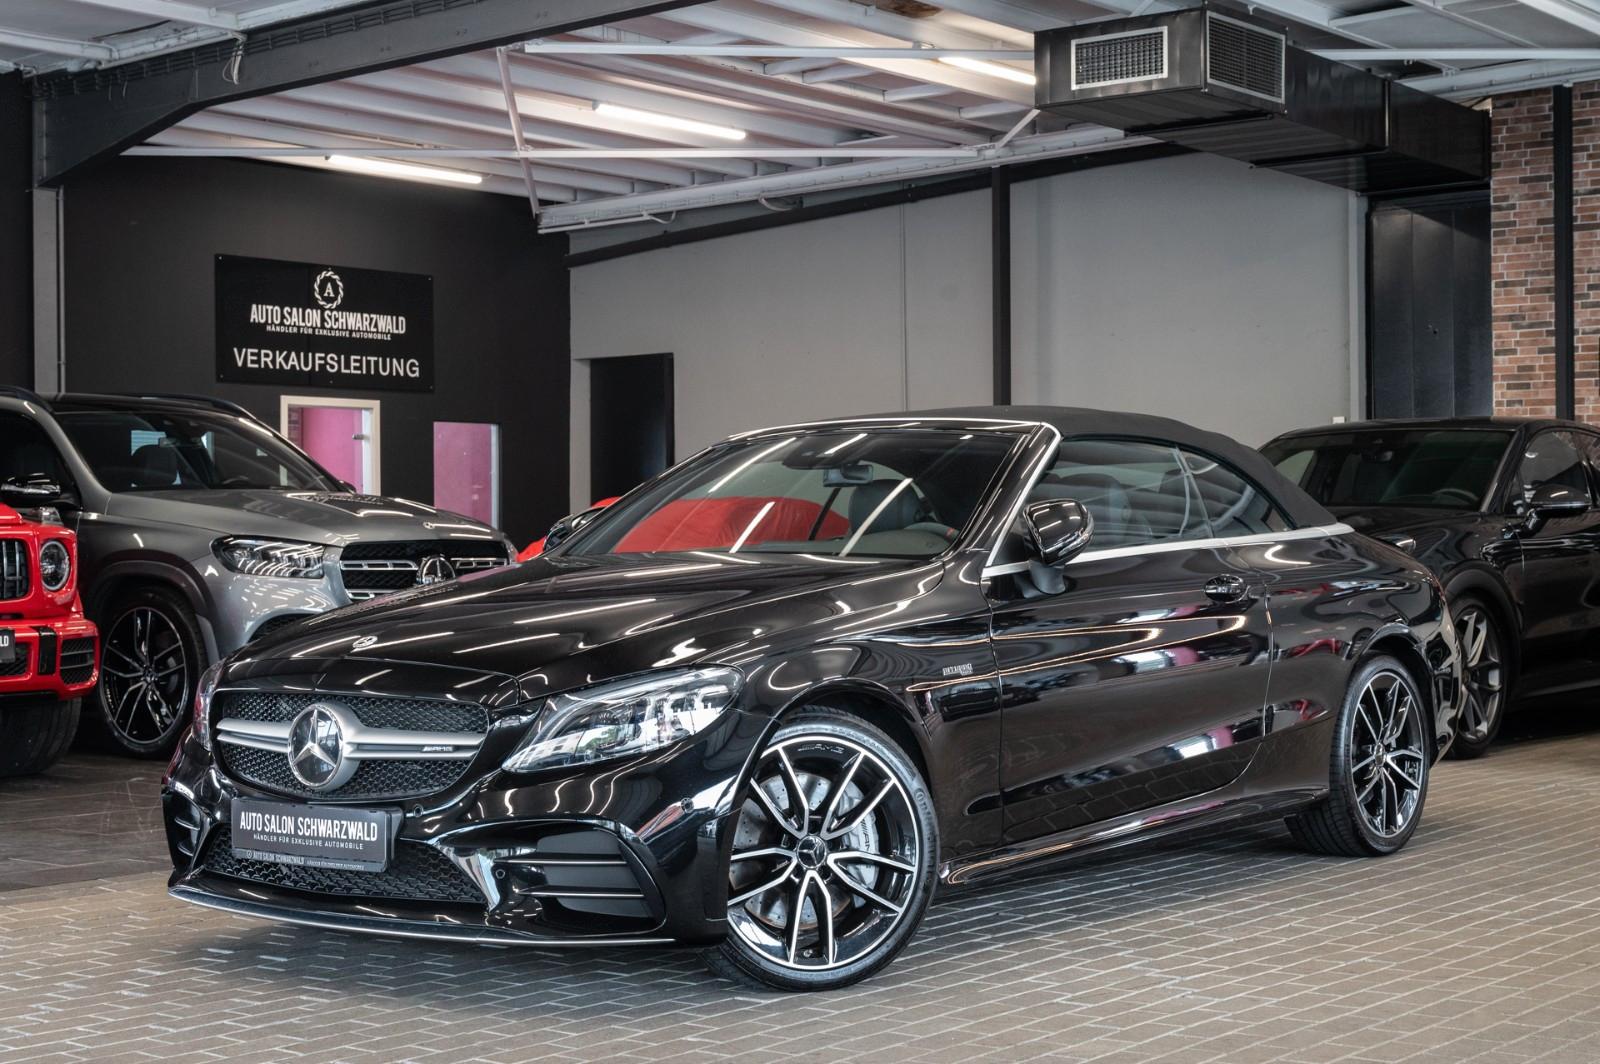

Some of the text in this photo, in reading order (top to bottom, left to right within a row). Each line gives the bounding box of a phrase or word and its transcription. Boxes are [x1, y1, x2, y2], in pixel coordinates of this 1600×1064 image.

[324, 282, 334, 297] A
[250, 304, 406, 334] AUTO SALON SCHWARZWALD
[266, 325, 392, 341] HÄNDLER FÜR EXKLUSIVE AUTOMOBILE
[233, 347, 420, 378] VERKAUFSLEITUNG
[240, 811, 378, 842] AUTO SALON SCHWARZWALD
[253, 833, 364, 850] HÄNDLER FÜR EXKLUSIVE AUTOMOBILE
